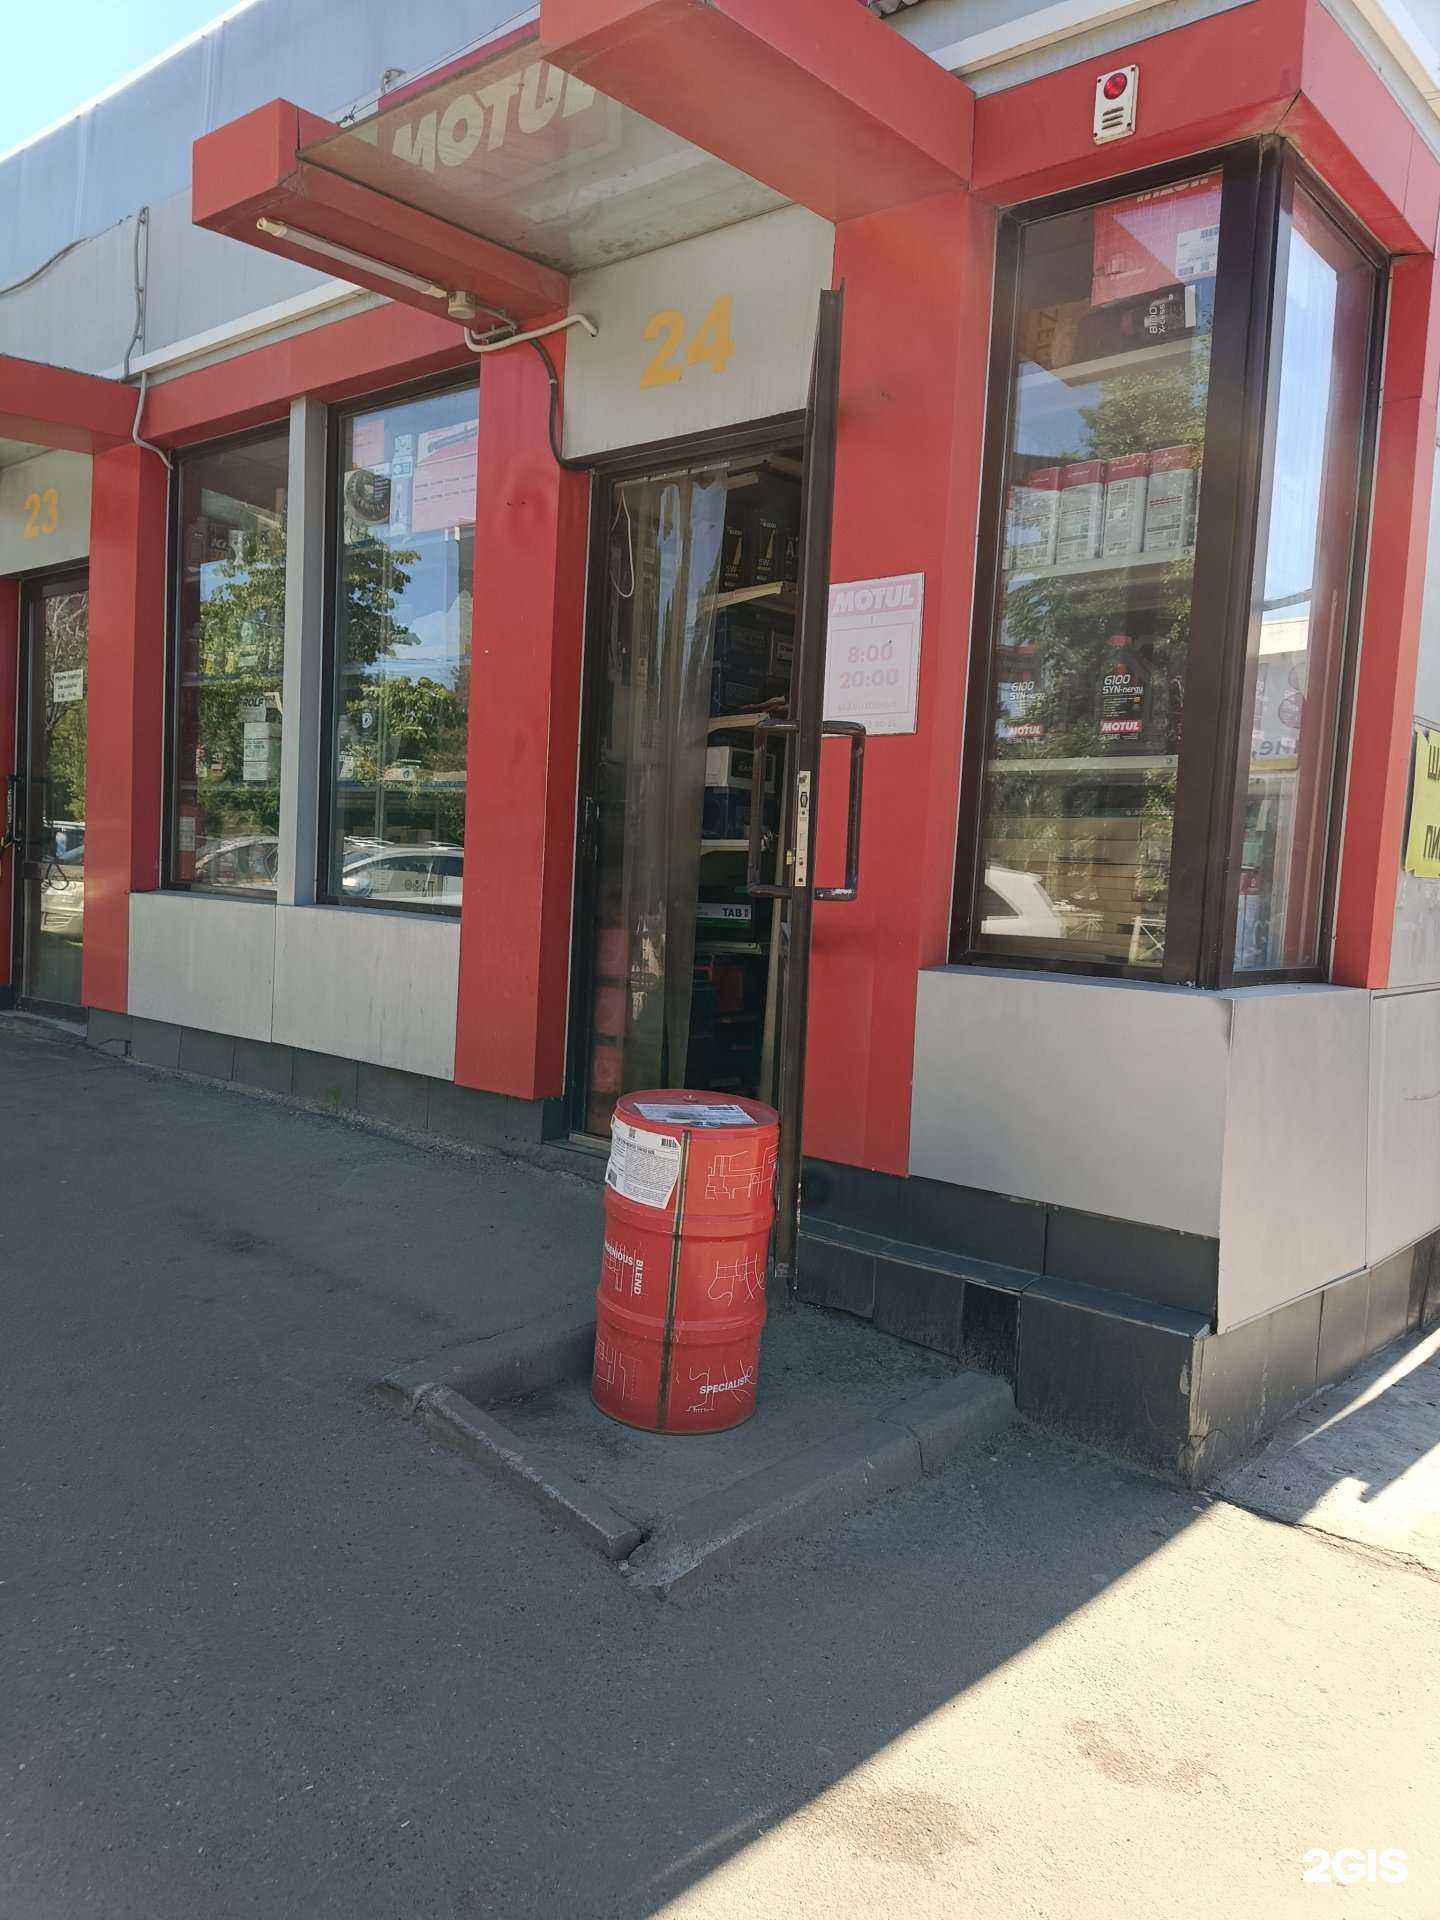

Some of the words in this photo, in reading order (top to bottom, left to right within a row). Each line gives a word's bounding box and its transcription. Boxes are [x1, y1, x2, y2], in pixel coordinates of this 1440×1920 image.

[640, 295, 736, 389] 24
[24, 488, 58, 539] 23
[833, 584, 914, 614] MOTUL
[848, 643, 893, 664] 8:00
[840, 668, 898, 689] 20:00
[1104, 674, 1131, 686] 6100
[1008, 724, 1041, 736] MOTUL
[1101, 721, 1140, 732] MOTUL
[633, 1259, 644, 1295] BLEND
